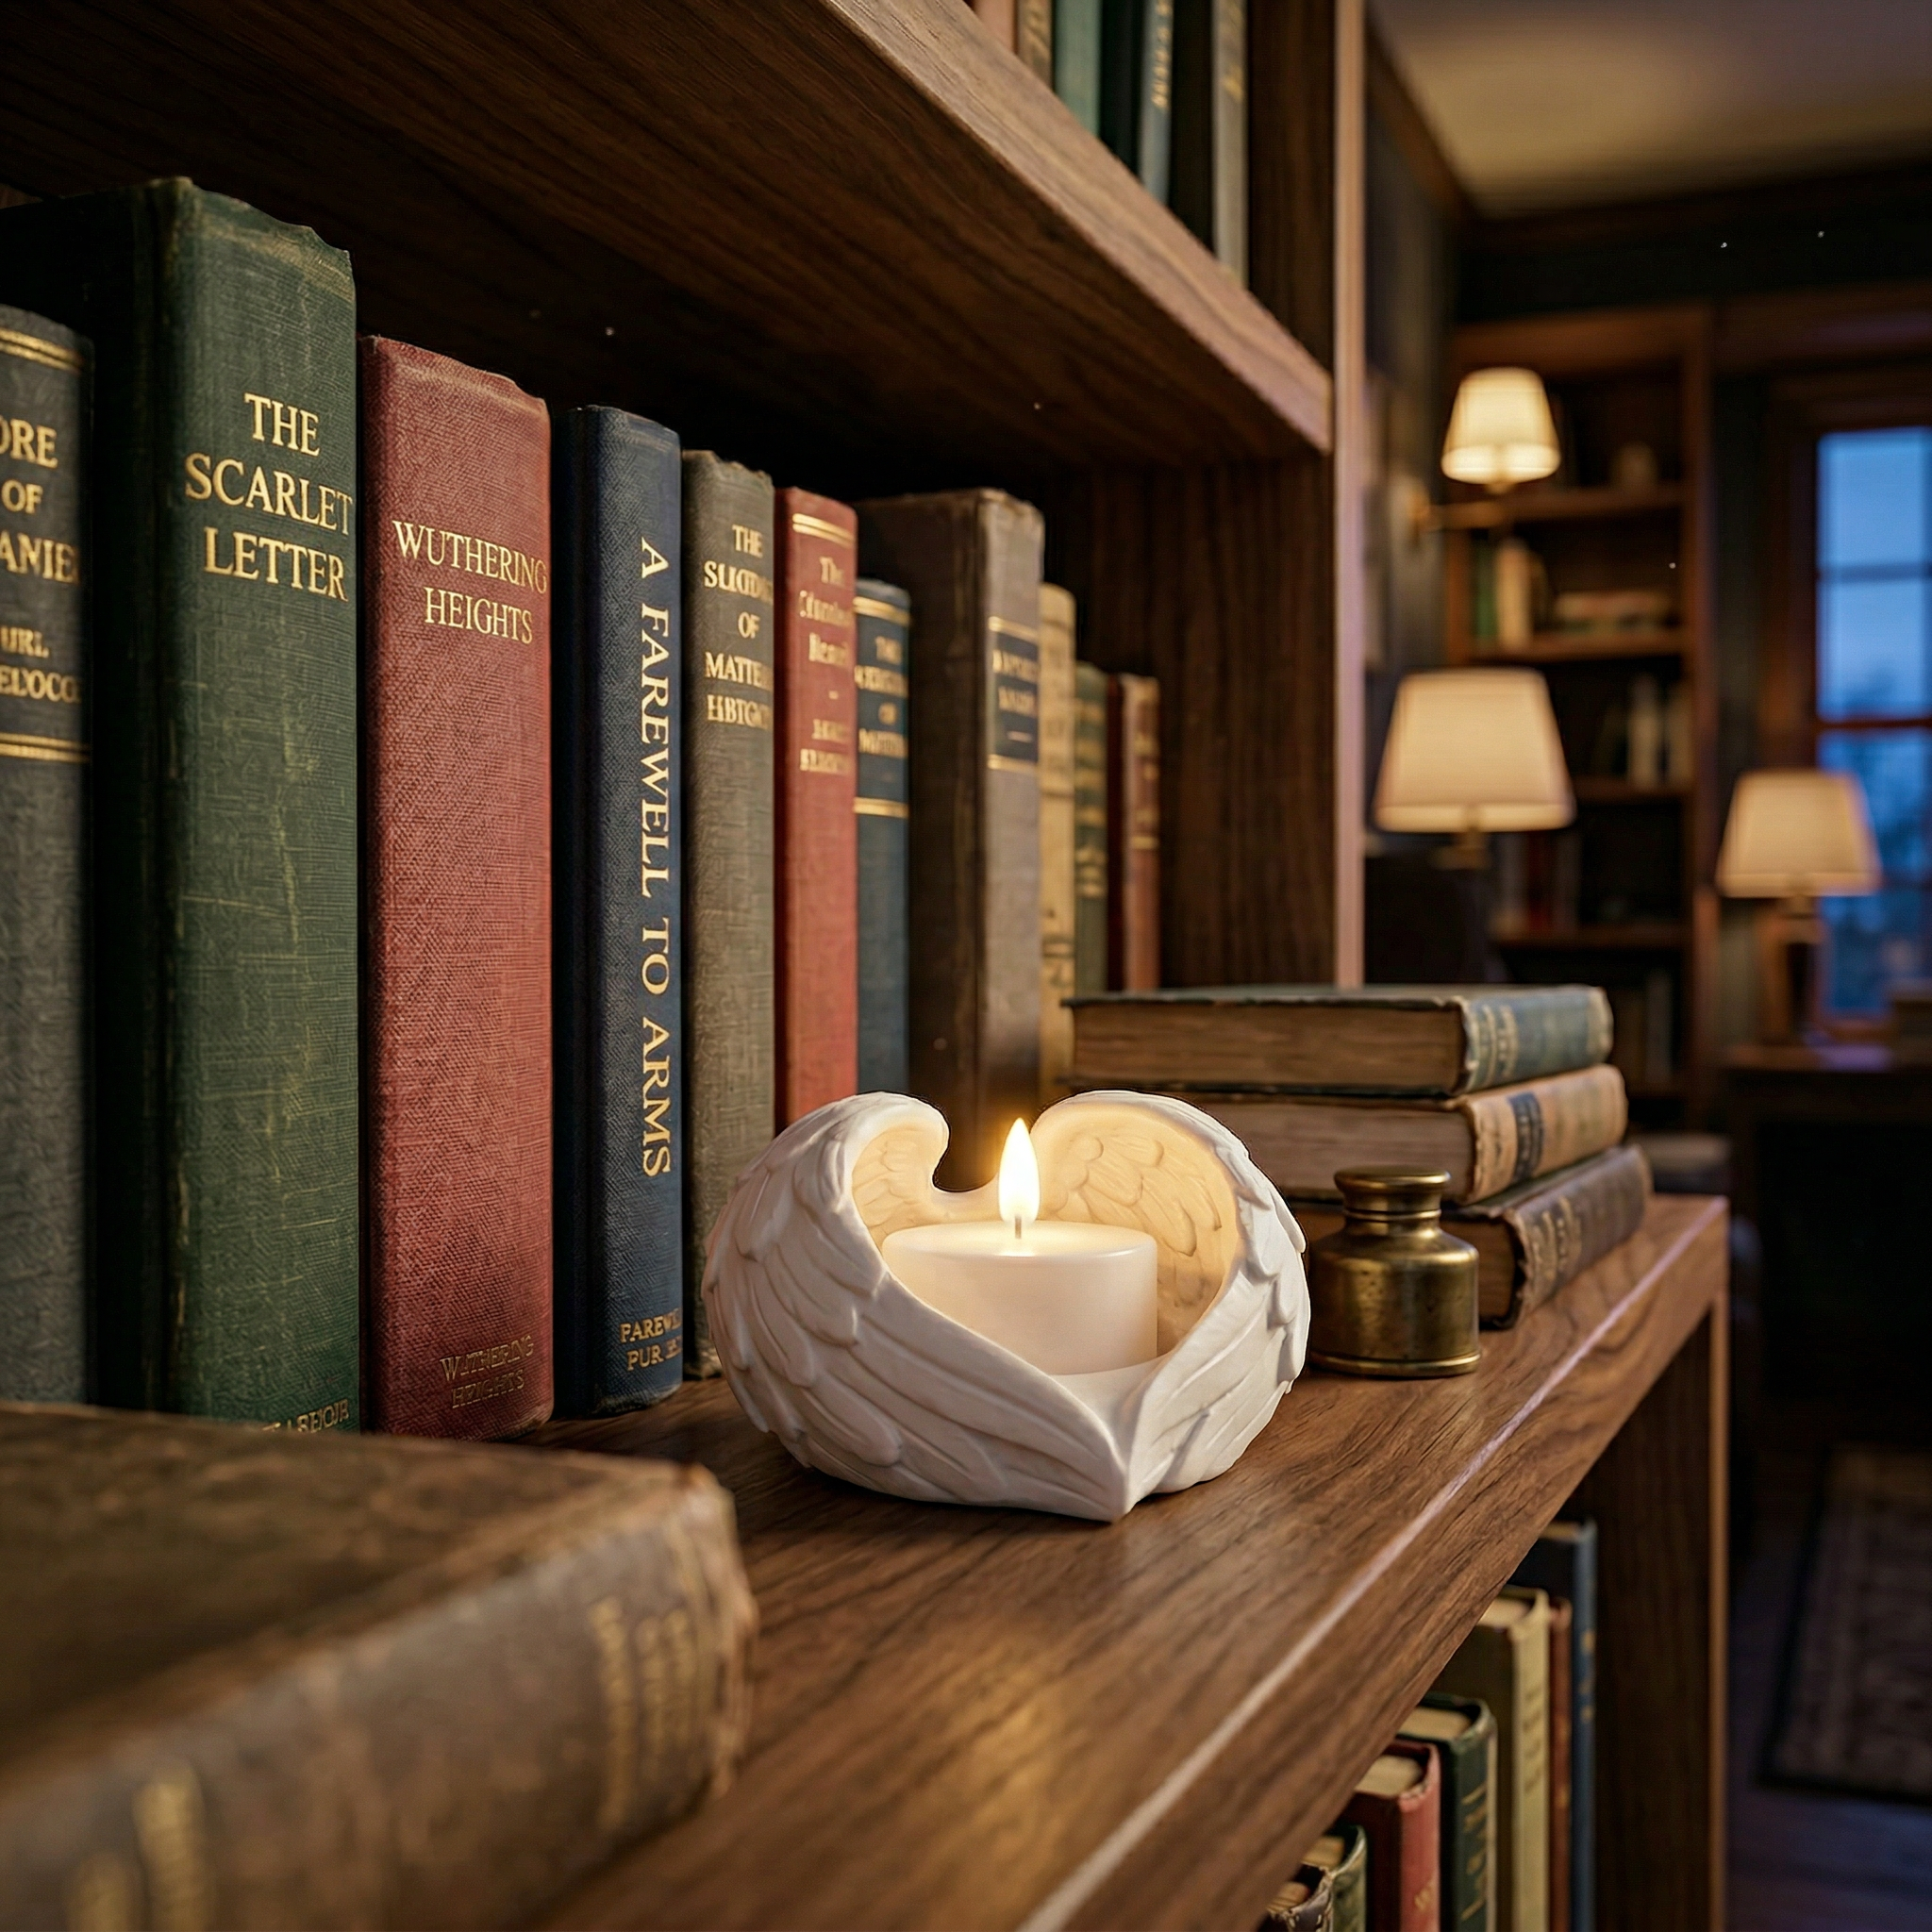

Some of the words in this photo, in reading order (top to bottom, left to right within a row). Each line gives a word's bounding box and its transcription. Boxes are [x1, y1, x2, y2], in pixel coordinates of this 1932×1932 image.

[243, 392, 321, 458] THE
[1, 479, 43, 514] OF
[184, 453, 354, 536] SCARLET
[0, 529, 80, 586] ANIE
[204, 526, 350, 602] LETTER
[392, 520, 547, 594] WUTHERING
[641, 537, 669, 579] A
[731, 524, 764, 558] THE
[424, 587, 533, 644] HEIGHTS
[738, 611, 760, 640] OF
[641, 602, 670, 899] FAREWELL
[641, 917, 670, 995] TO
[642, 1016, 671, 1177] ARMS
